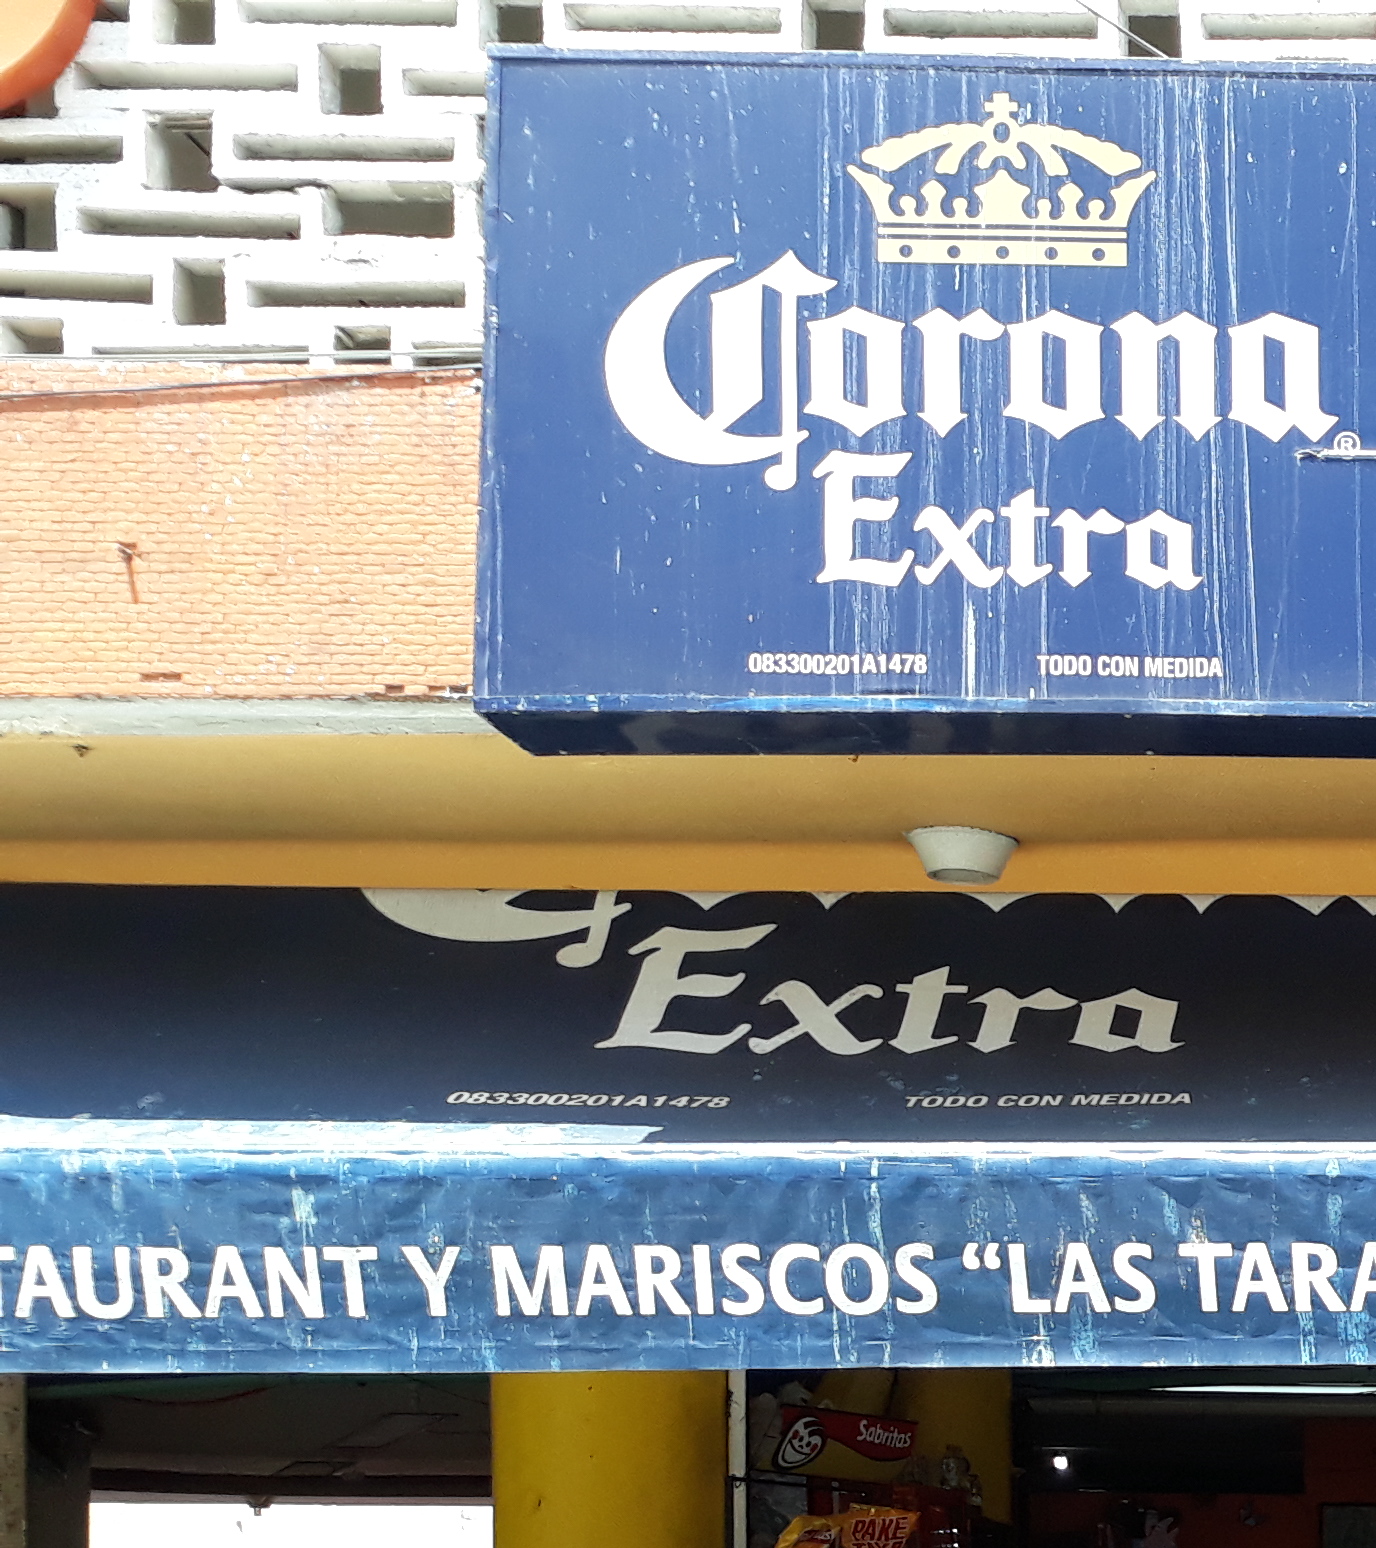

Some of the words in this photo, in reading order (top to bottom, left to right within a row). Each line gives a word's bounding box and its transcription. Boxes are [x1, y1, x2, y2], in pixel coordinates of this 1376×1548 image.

[605, 249, 1338, 490] Corona
[813, 449, 1204, 590] Extra
[748, 653, 928, 675] 083300201A1478
[1036, 654, 1094, 676] TODO
[1098, 654, 1143, 676] CON
[1146, 655, 1223, 678] MEDIDA
[593, 922, 1184, 1056] Extra
[446, 1091, 730, 1109] 083300201A1478
[906, 1094, 989, 1109] TODO
[997, 1093, 1063, 1108] CON
[1069, 1092, 1192, 1107] MEDIDA
[415, 1244, 461, 1318] Y
[493, 1242, 938, 1317] MARISCOS
[857, 1420, 912, 1448] Sabritas
